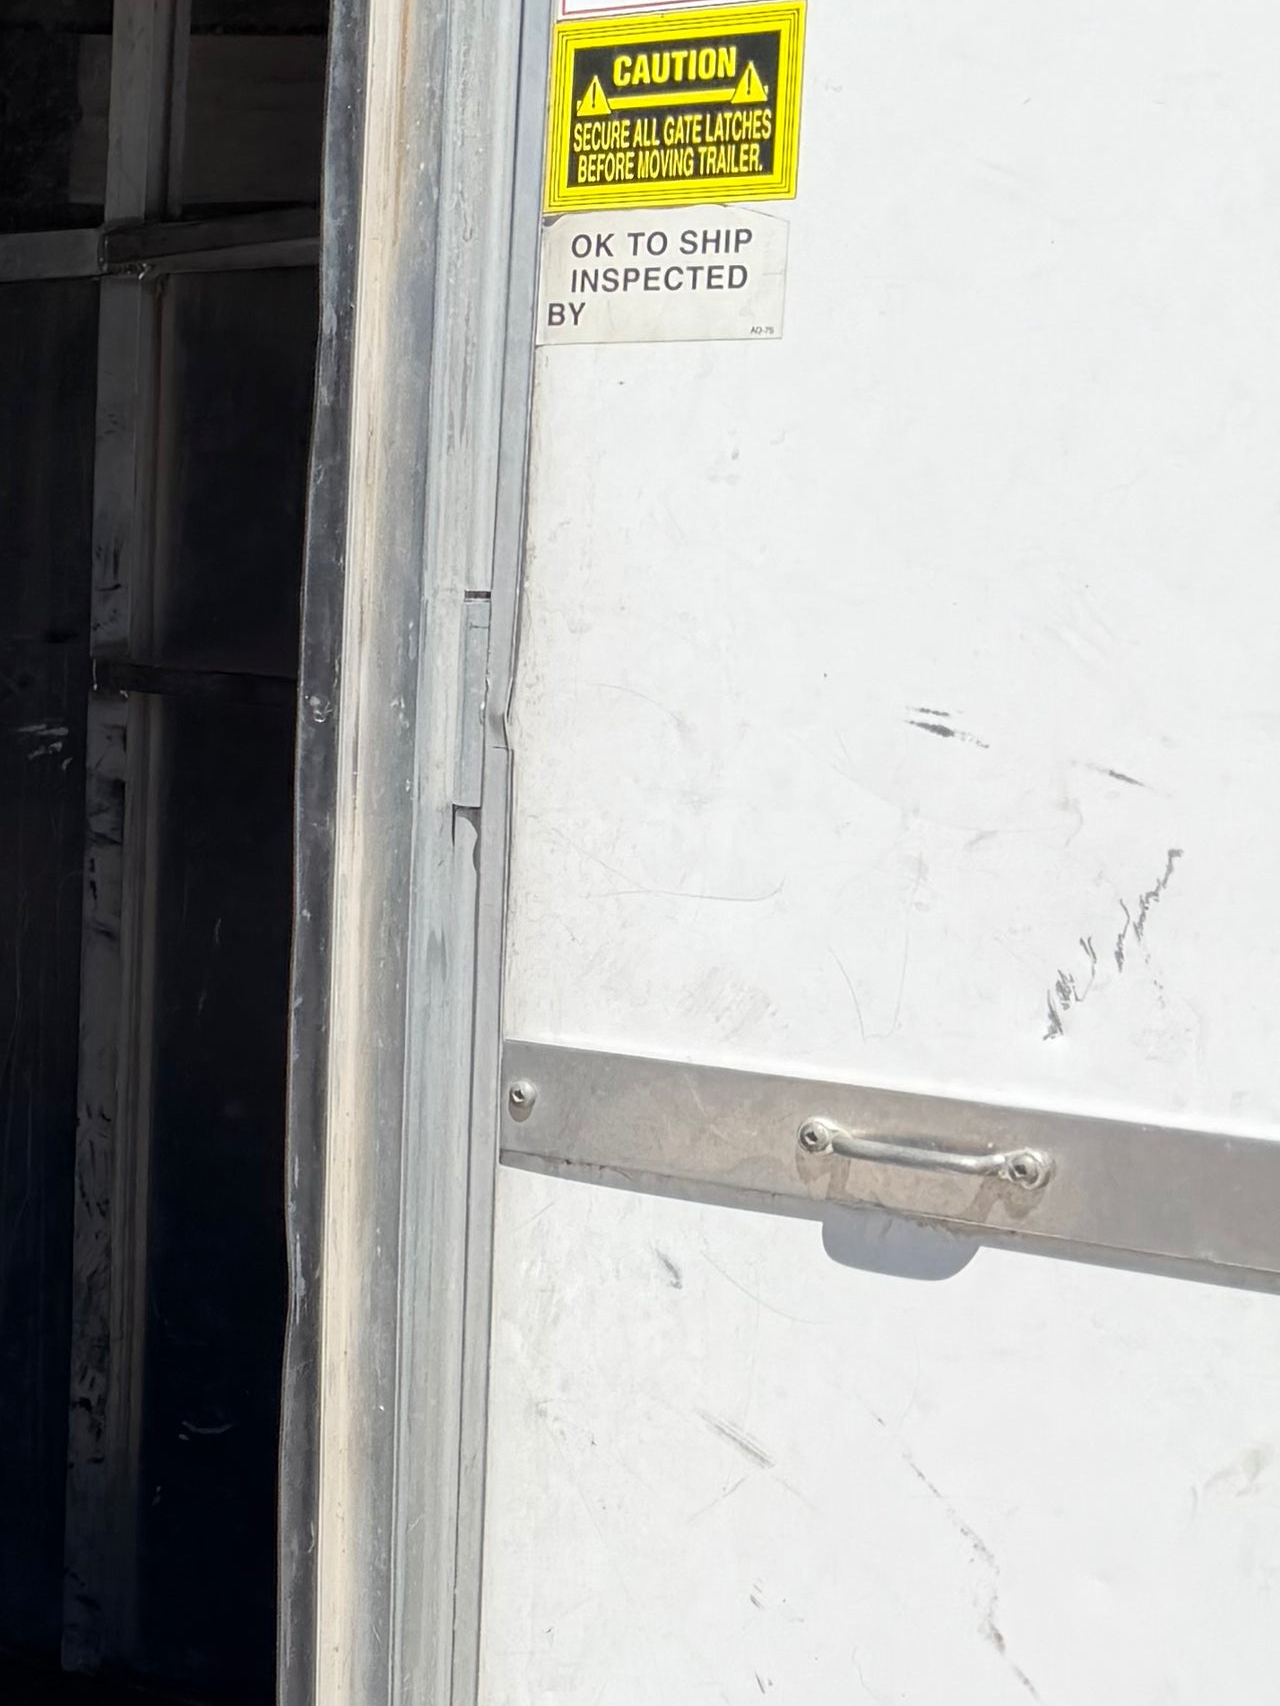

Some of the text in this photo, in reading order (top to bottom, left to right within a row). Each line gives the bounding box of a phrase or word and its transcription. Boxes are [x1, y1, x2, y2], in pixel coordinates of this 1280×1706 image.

[613, 46, 737, 87] CAUTION
[573, 109, 772, 152] SECURE ALL GATE LATCHES
[577, 143, 763, 183] BEFORE MOVING TRAILER.
[571, 228, 753, 258] OK TO SHIP
[570, 264, 748, 293] INSPECTED
[547, 302, 586, 326] BY
